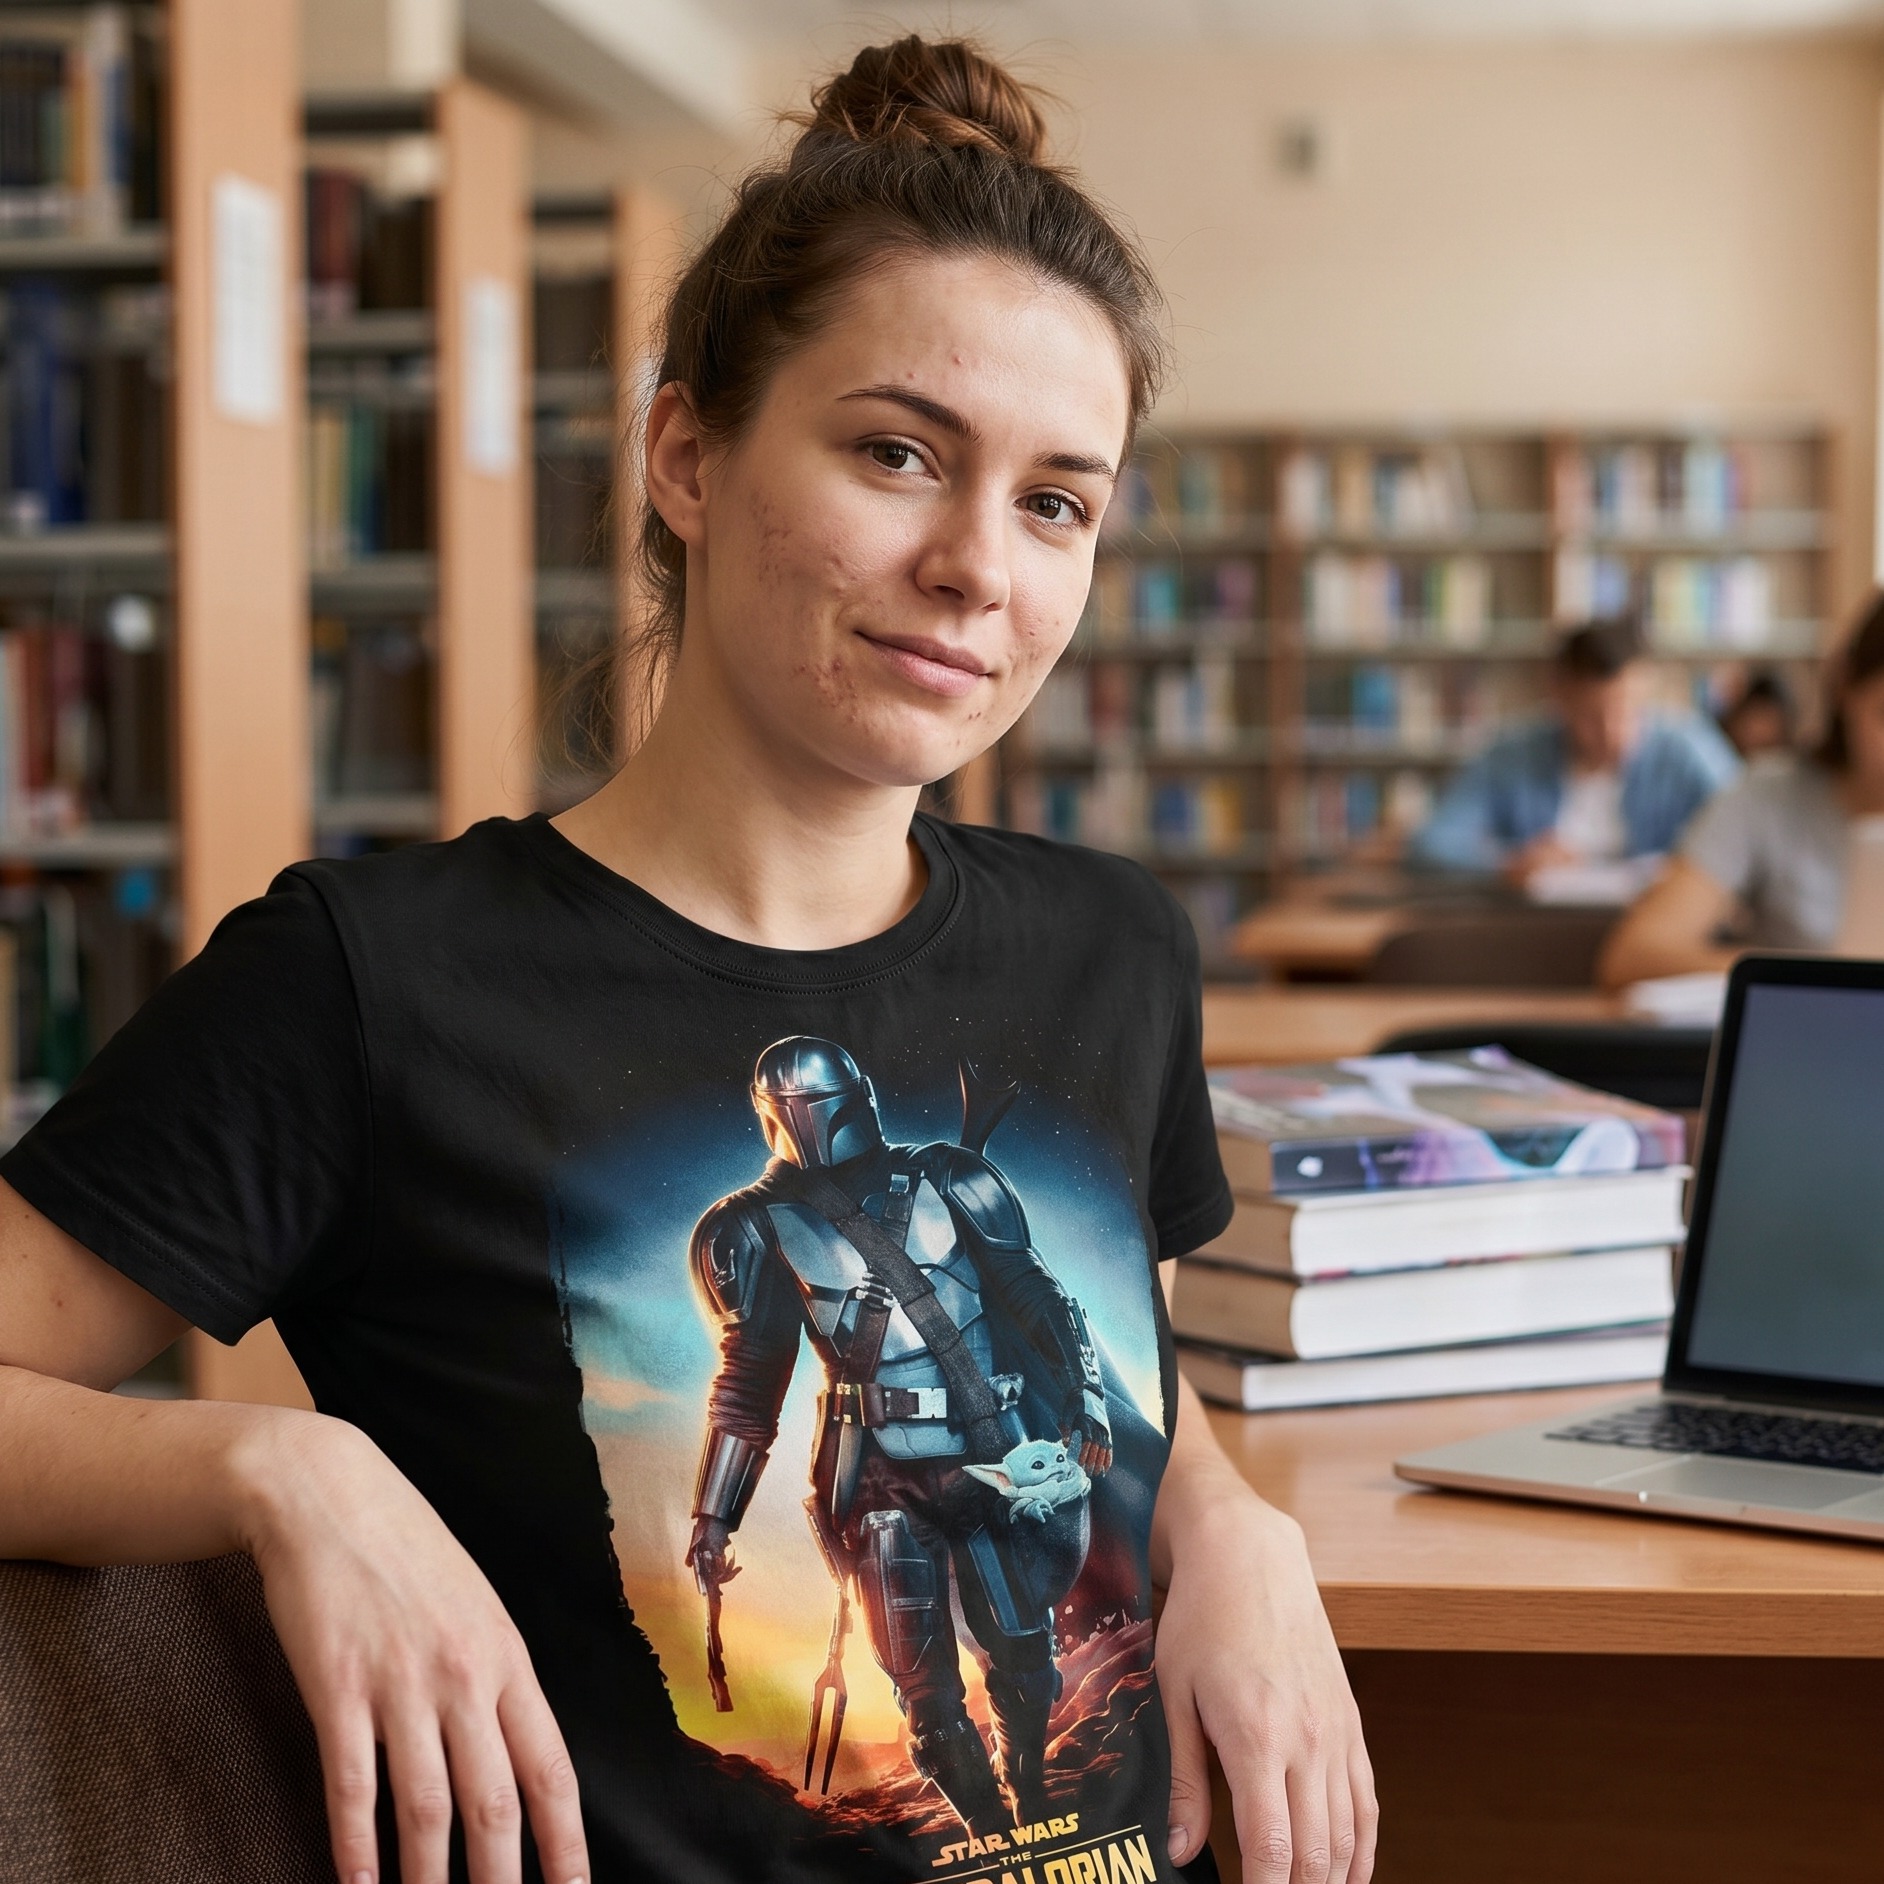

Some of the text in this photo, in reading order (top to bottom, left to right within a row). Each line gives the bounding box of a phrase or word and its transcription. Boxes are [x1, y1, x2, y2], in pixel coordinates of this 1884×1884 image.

[931, 1812, 1079, 1868] STAR WARS
[999, 1851, 1033, 1867] THE
